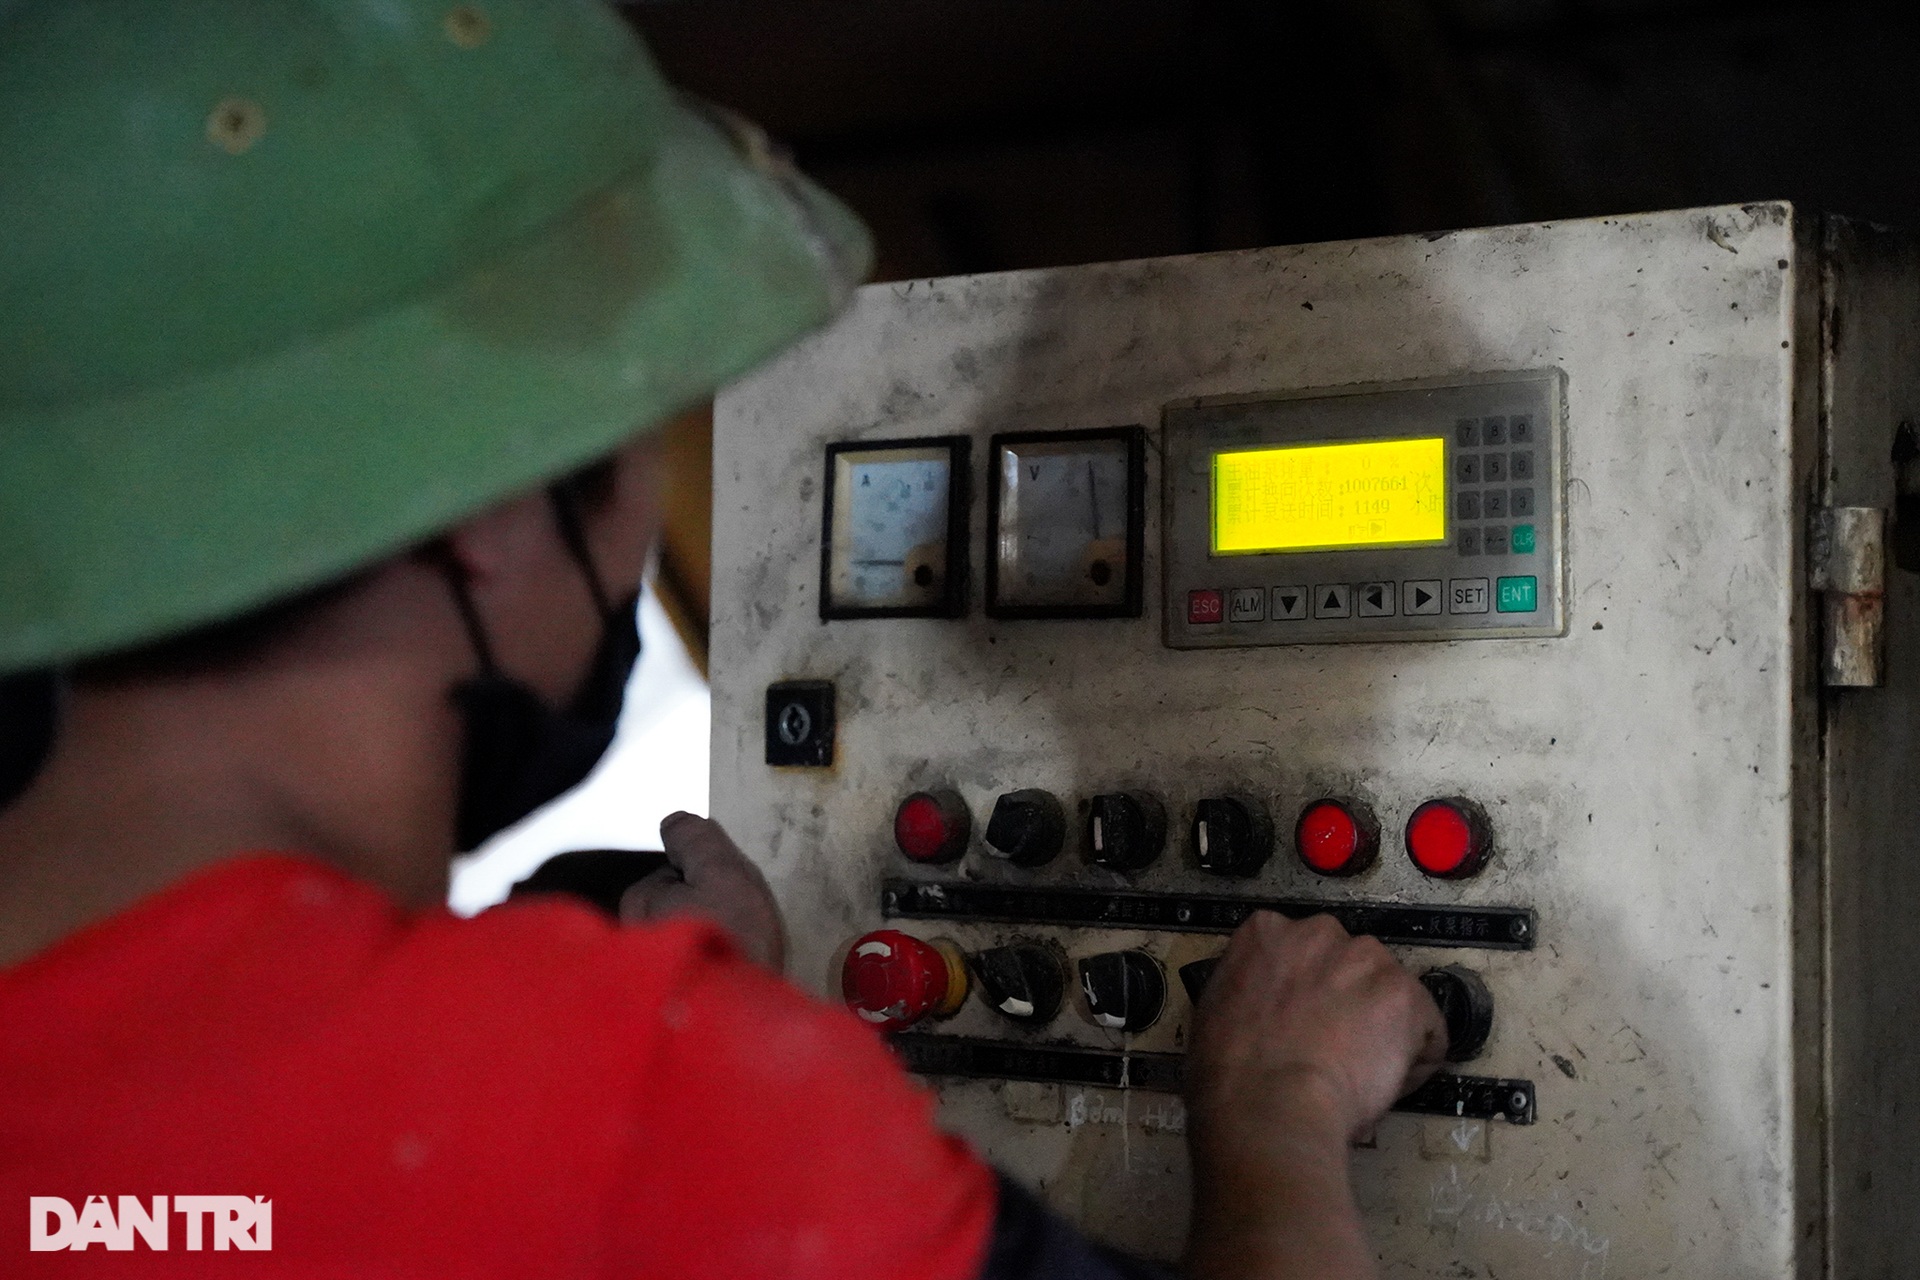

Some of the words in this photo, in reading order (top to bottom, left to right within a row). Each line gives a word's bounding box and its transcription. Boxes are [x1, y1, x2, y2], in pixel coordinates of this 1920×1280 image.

[1465, 426, 1472, 438] 7
[1490, 424, 1499, 437] 8
[1518, 423, 1526, 435] 9
[1029, 465, 1040, 481] V
[1463, 463, 1472, 475] 4
[1491, 461, 1499, 474] 5
[860, 473, 871, 487] A
[1354, 498, 1391, 515] 1149
[1491, 497, 1500, 511] 2
[1519, 496, 1527, 509] 3
[1464, 535, 1473, 549] 0
[1512, 531, 1535, 547] CLR
[1454, 588, 1483, 604] SET
[1501, 585, 1532, 603] ENT
[1191, 598, 1220, 614] ESC
[1234, 596, 1261, 612] ALM
